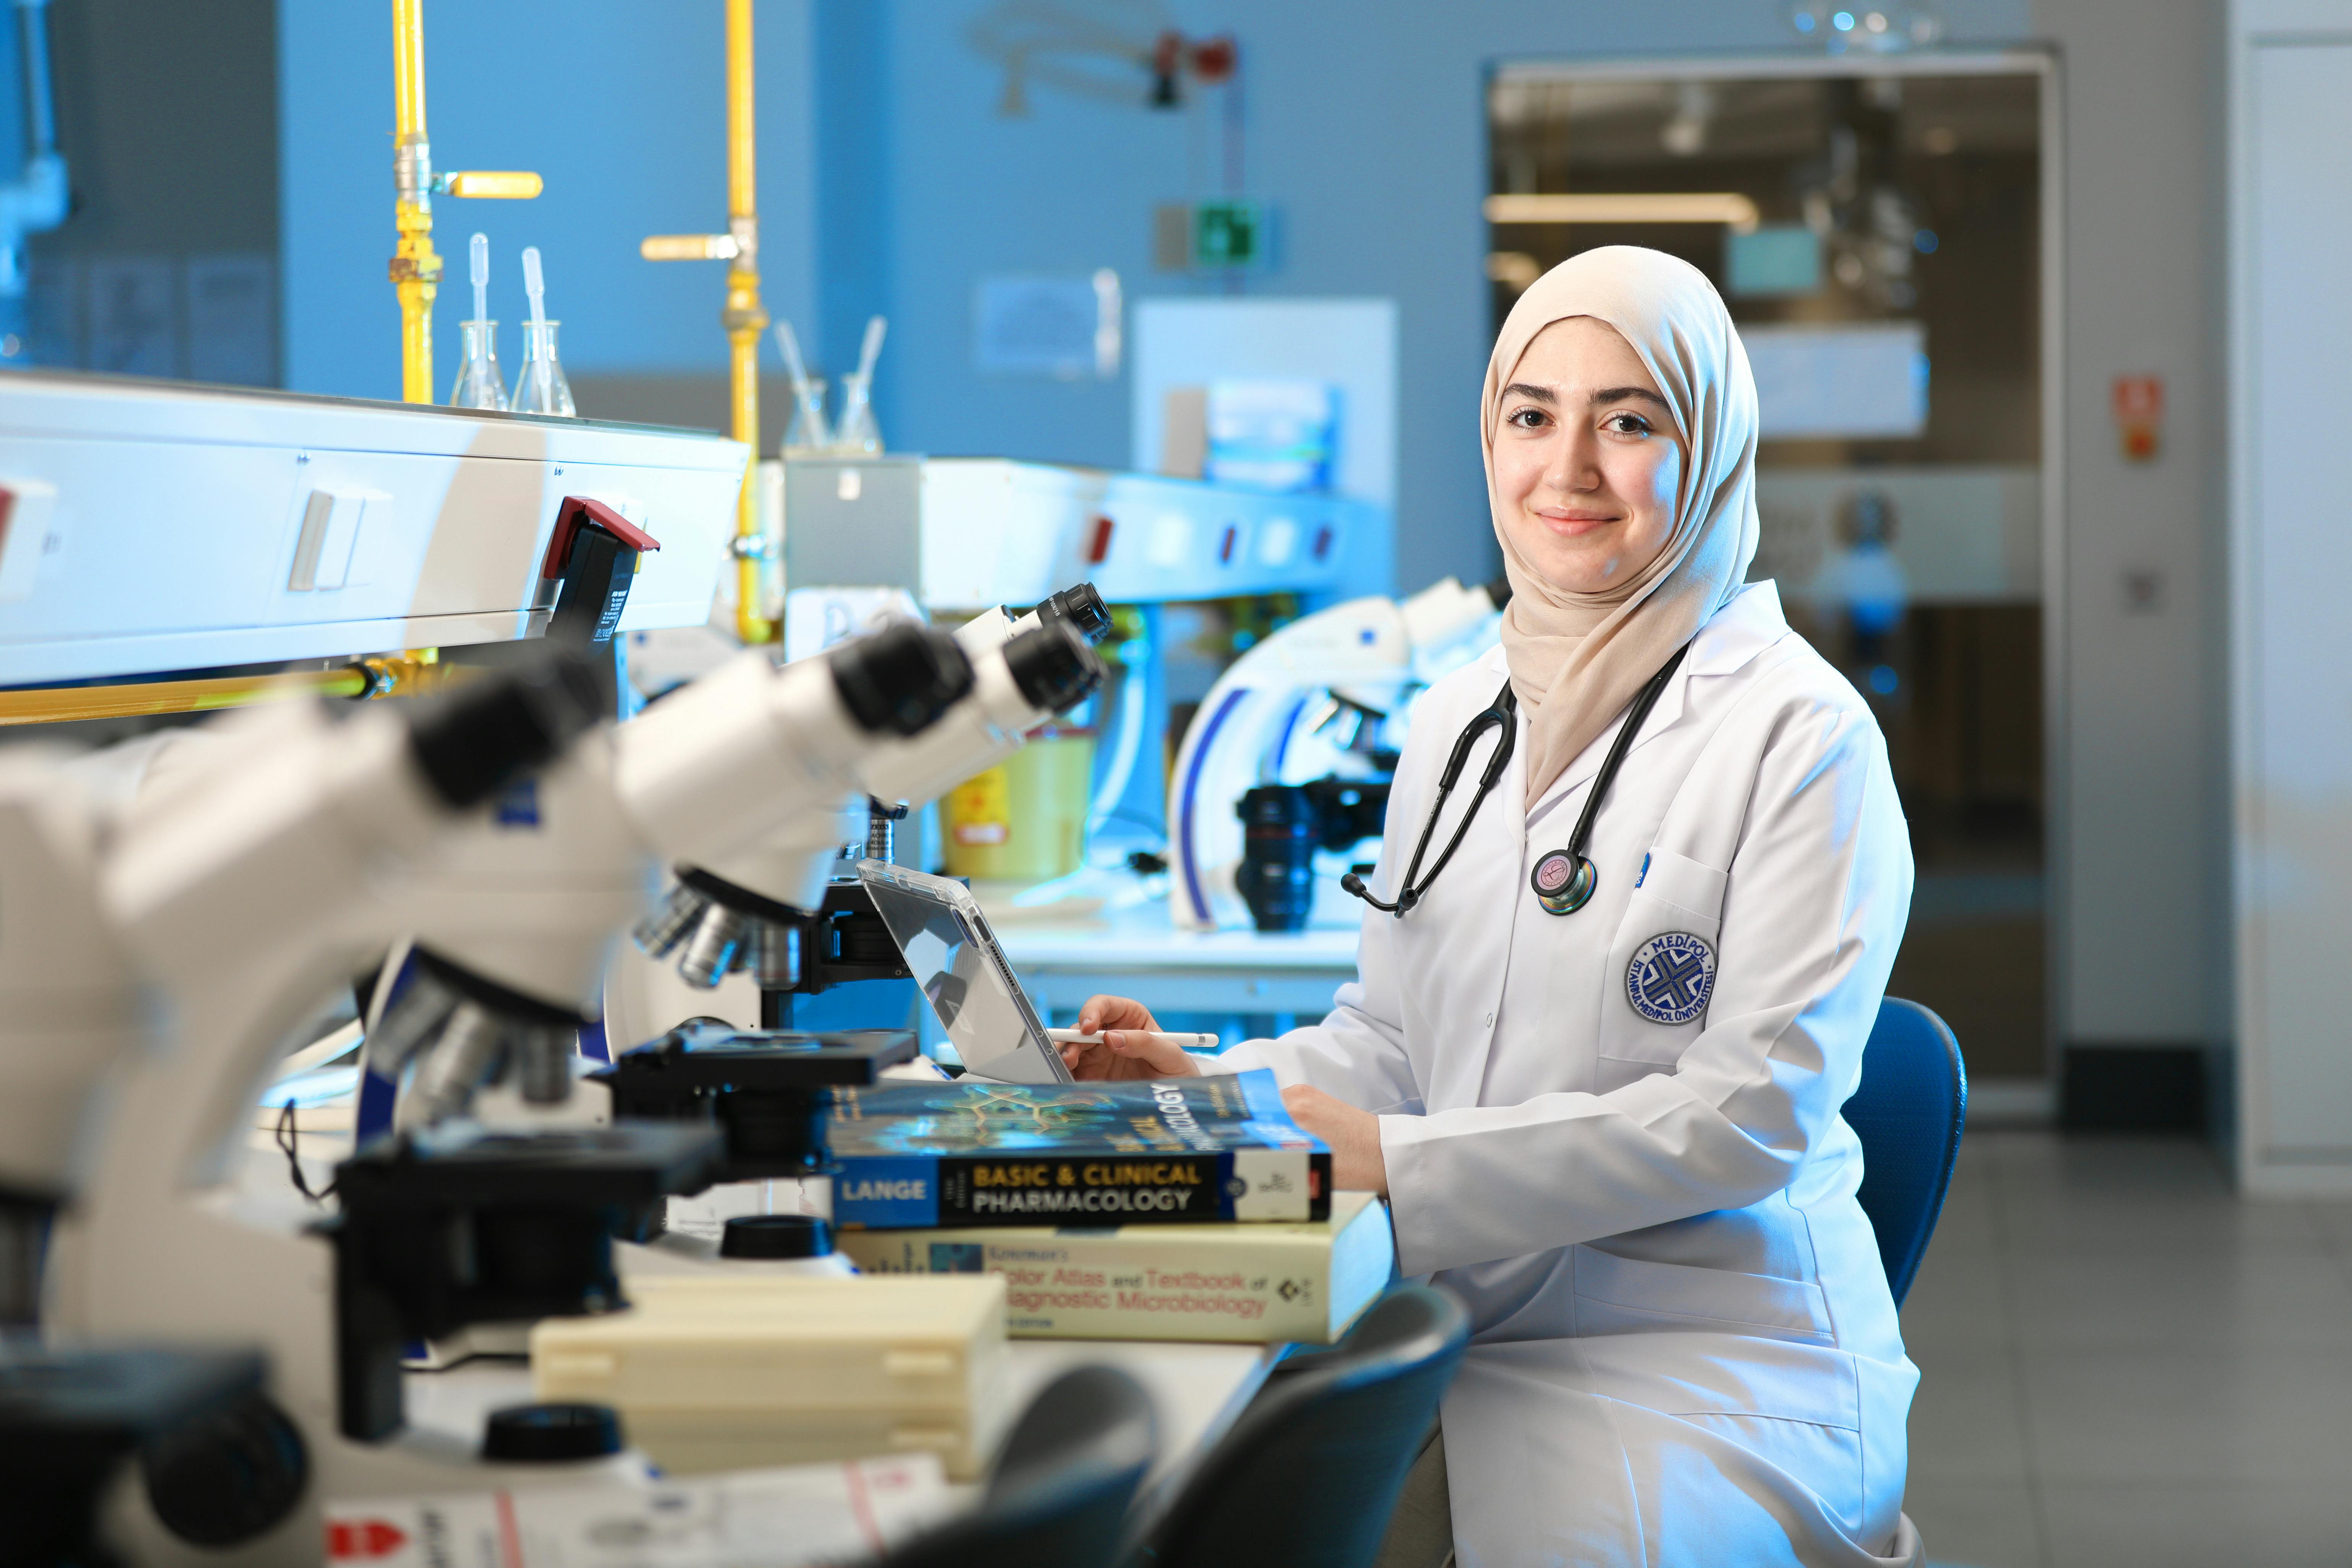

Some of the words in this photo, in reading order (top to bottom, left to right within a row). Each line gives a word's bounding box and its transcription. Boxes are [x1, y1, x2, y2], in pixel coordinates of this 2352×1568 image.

[972, 1164, 1049, 1187] BASIC
[1056, 1163, 1075, 1186] &
[1083, 1163, 1202, 1185] CLINICAL
[842, 1180, 927, 1201] LANGE
[973, 1189, 1192, 1212] PHARMACOLOGY
[990, 1267, 1046, 1285] olor
[1053, 1268, 1107, 1287] Atlas
[1113, 1276, 1142, 1288] and
[1145, 1267, 1246, 1290] Textbook
[1250, 1276, 1268, 1291] of
[1116, 1291, 1268, 1320] Microbiology
